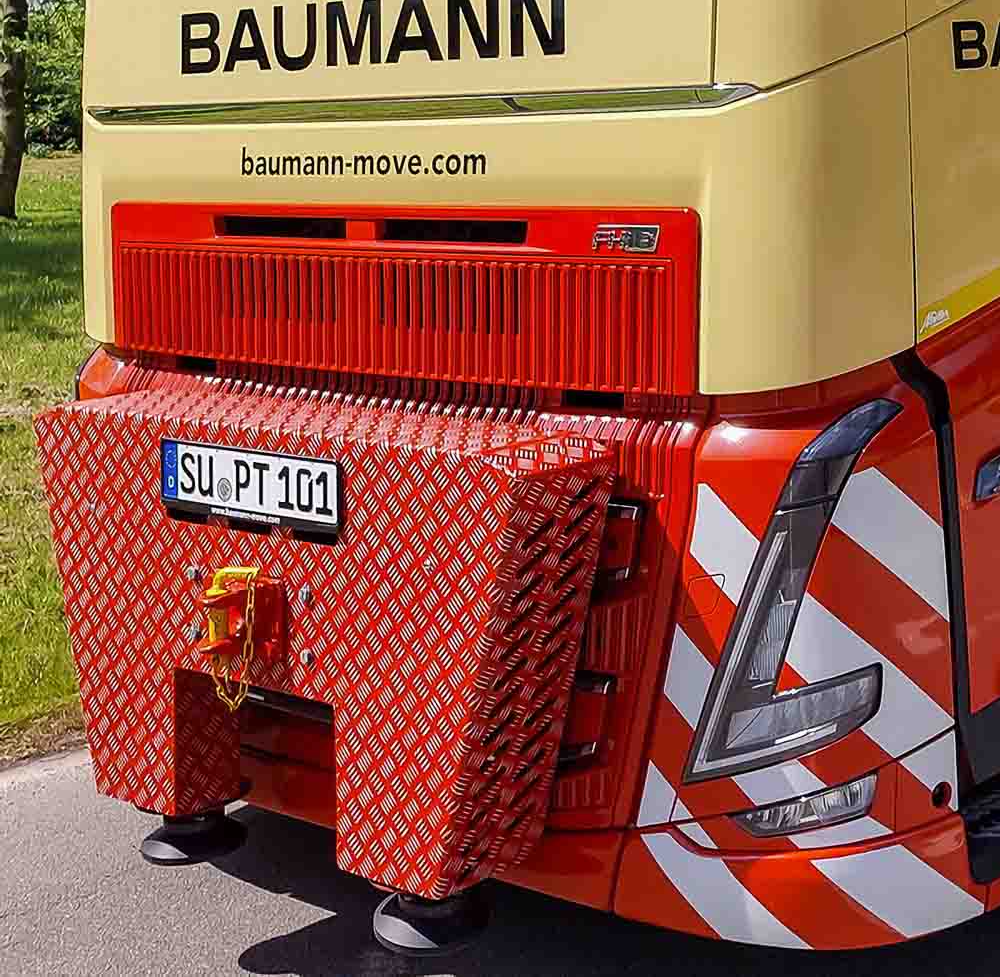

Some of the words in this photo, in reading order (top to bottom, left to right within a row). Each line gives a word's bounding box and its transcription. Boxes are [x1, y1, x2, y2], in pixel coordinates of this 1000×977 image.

[240, 146, 487, 176] baumann-move.com
[180, 452, 214, 498] SU
[234, 459, 270, 507] PT
[278, 465, 334, 517] 101
